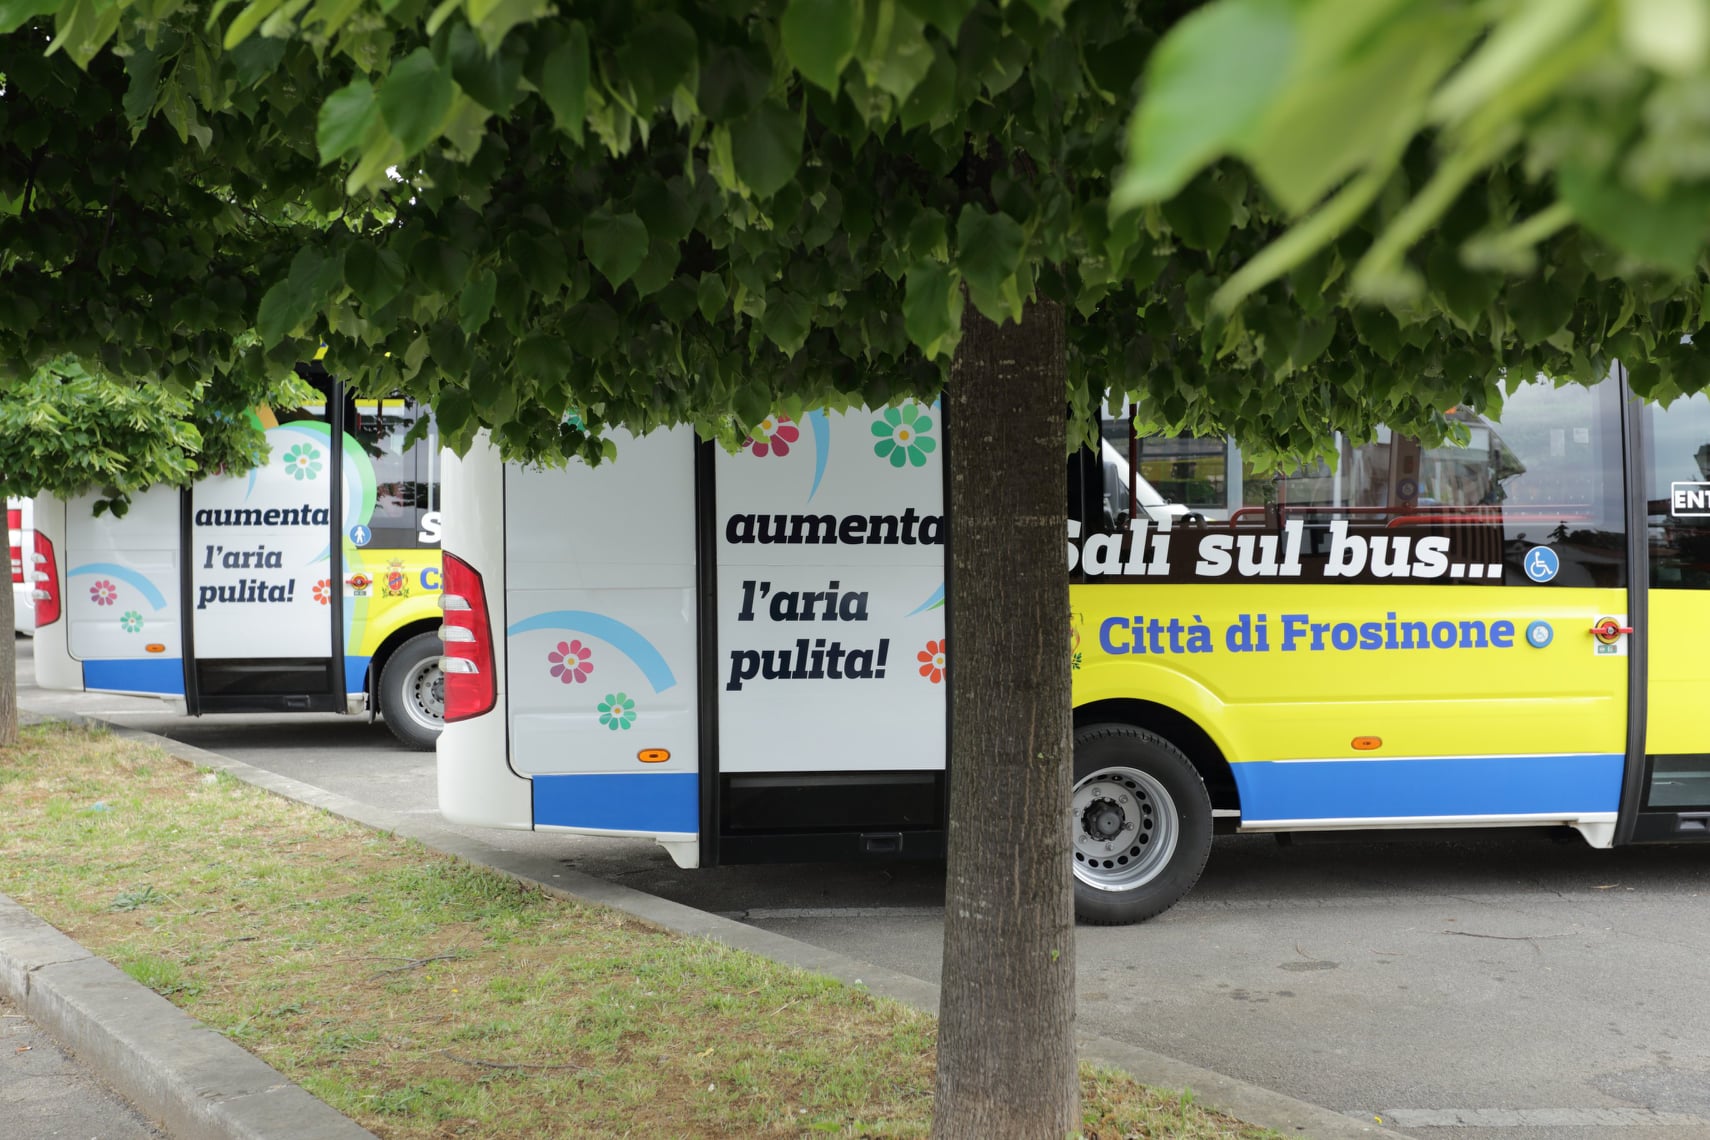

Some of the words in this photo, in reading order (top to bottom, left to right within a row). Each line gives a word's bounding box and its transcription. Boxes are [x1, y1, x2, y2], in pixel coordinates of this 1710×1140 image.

[195, 504, 329, 526] aumenta
[726, 507, 944, 545] aumenta
[1195, 519, 1303, 577] sul
[1323, 519, 1503, 578] bus...
[197, 578, 296, 609] pulita!
[1099, 614, 1213, 655] Città
[1225, 614, 1270, 652] di
[1281, 611, 1515, 651] Frosinone
[726, 638, 890, 691] pulita!
